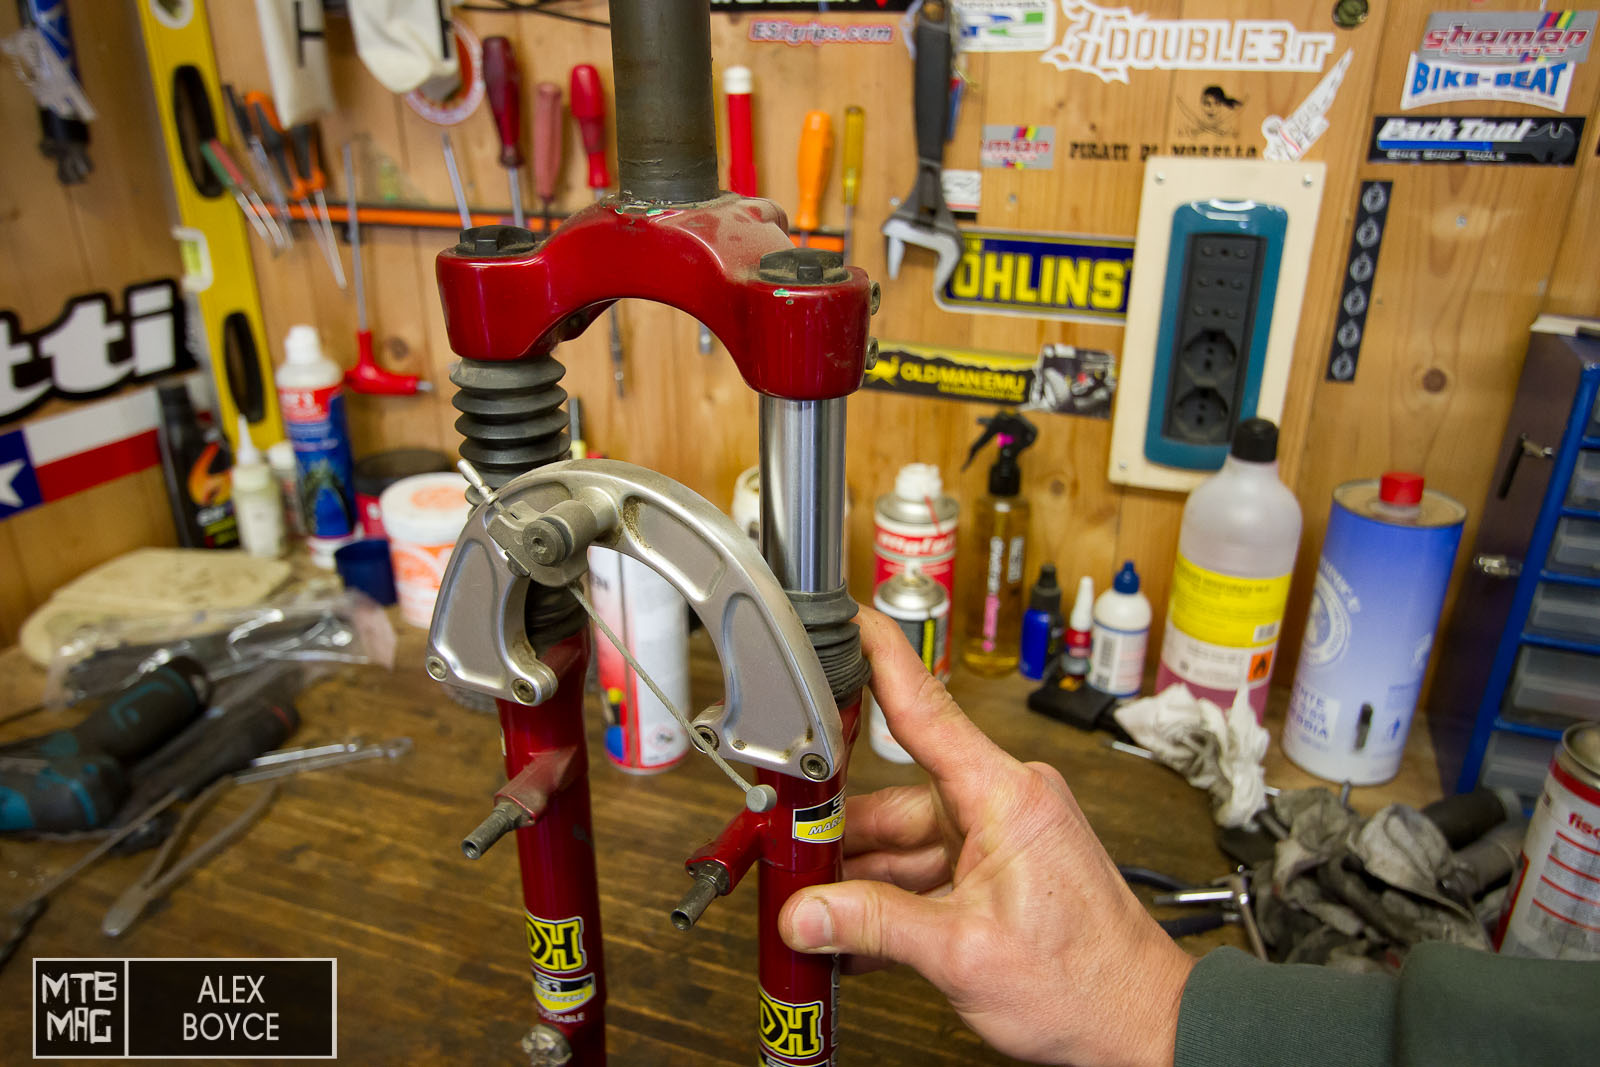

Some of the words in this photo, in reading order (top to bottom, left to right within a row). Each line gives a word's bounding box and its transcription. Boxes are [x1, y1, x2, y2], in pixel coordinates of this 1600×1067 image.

[1424, 22, 1589, 49] shaman
[1411, 61, 1567, 96] BIKE-BEAT
[1378, 118, 1457, 141] Park
[1457, 118, 1534, 141] Tool
[900, 362, 938, 384] OLD
[982, 371, 1026, 393] EMU
[525, 912, 583, 971] DH
[760, 987, 821, 1057] DH
